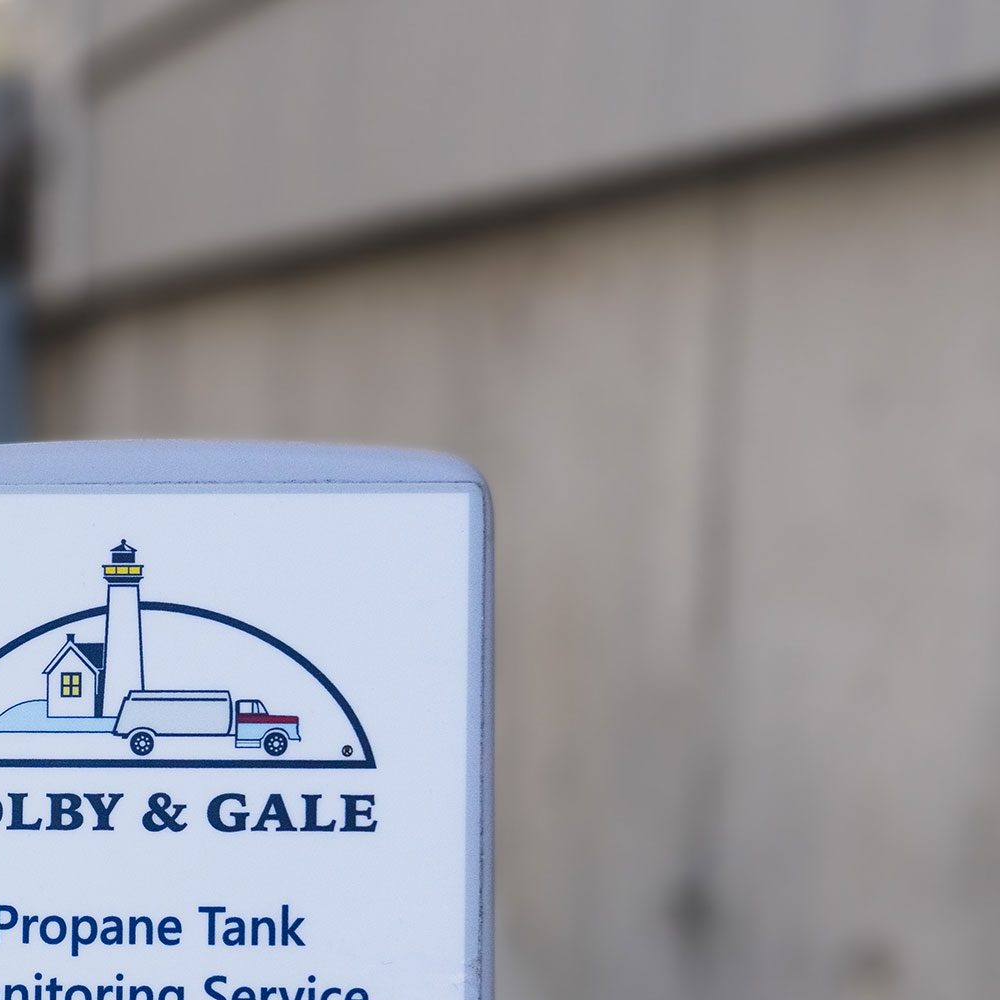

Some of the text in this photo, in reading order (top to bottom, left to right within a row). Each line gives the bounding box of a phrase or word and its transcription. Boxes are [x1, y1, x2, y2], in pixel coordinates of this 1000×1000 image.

[141, 792, 188, 833] &
[206, 792, 378, 833] GALE
[198, 904, 306, 947] Tank
